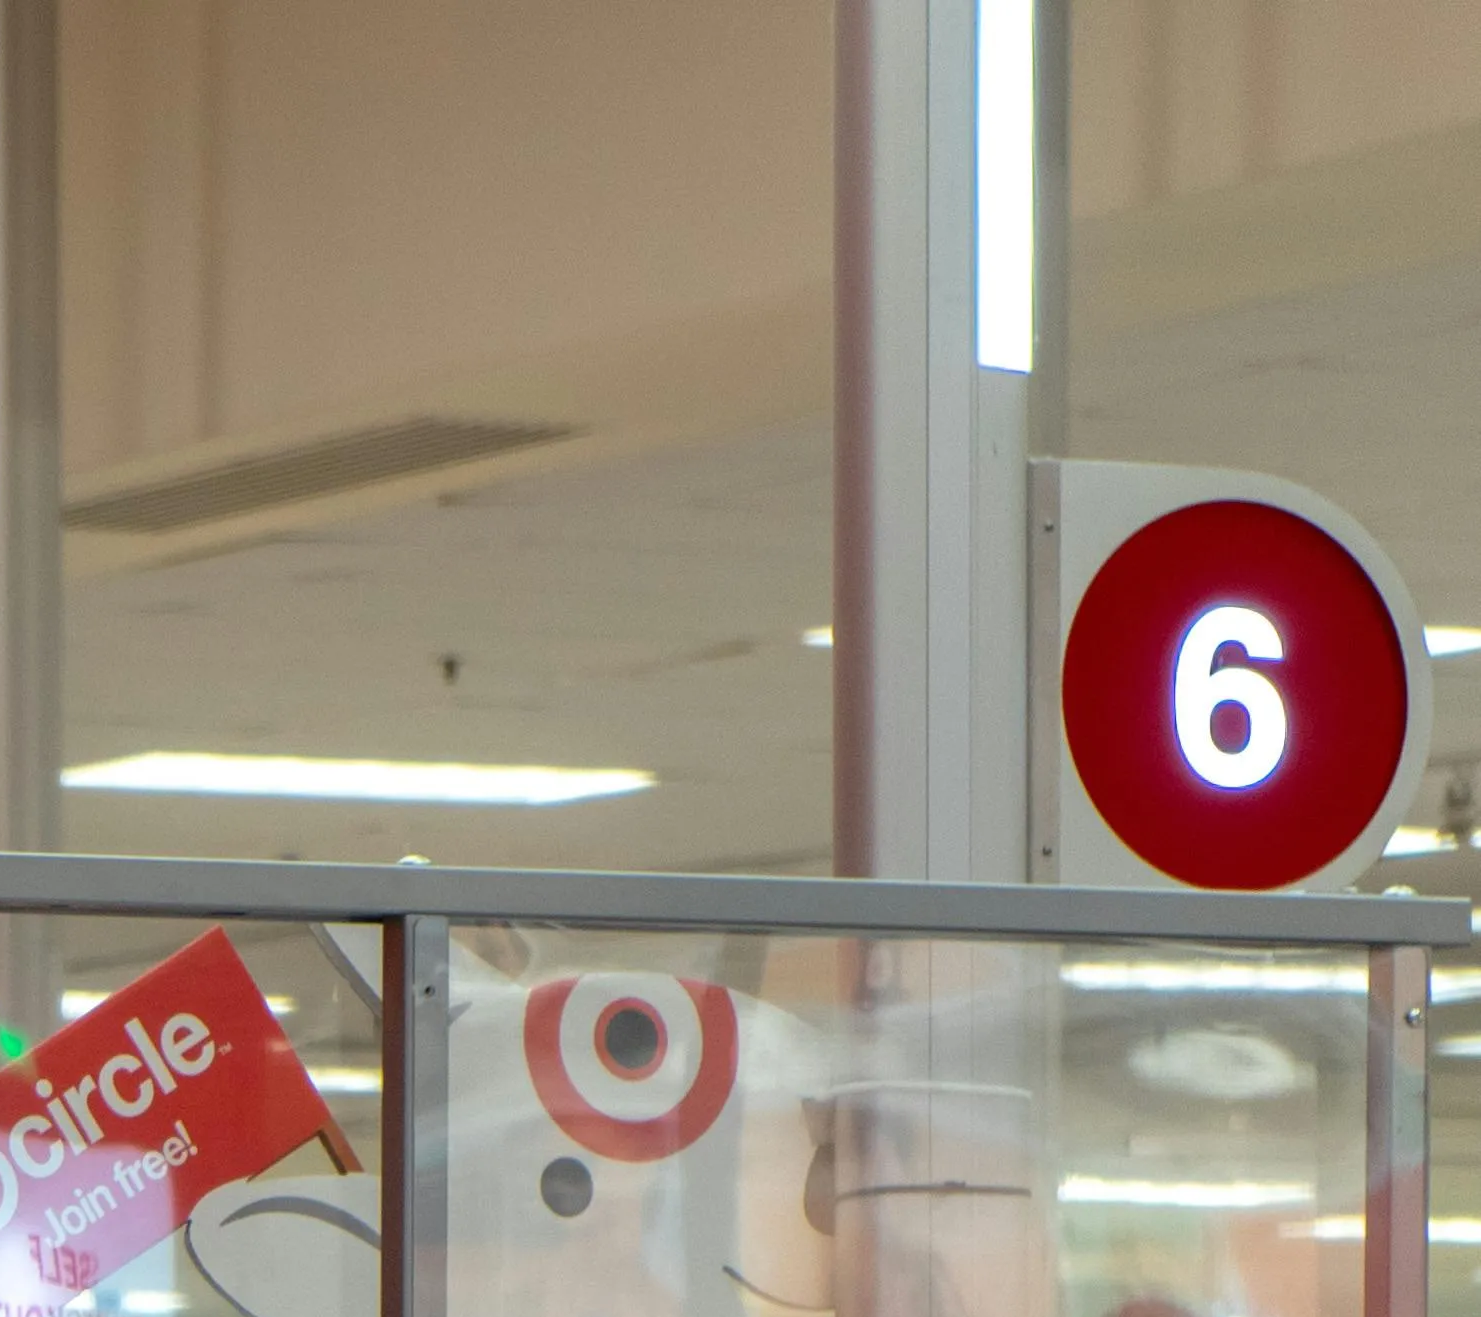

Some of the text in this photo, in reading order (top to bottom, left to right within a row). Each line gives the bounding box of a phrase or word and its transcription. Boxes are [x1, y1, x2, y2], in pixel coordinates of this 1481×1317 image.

[1175, 606, 1287, 789] 6
[8, 1010, 217, 1178] circle
[44, 1119, 199, 1248] Join free!
